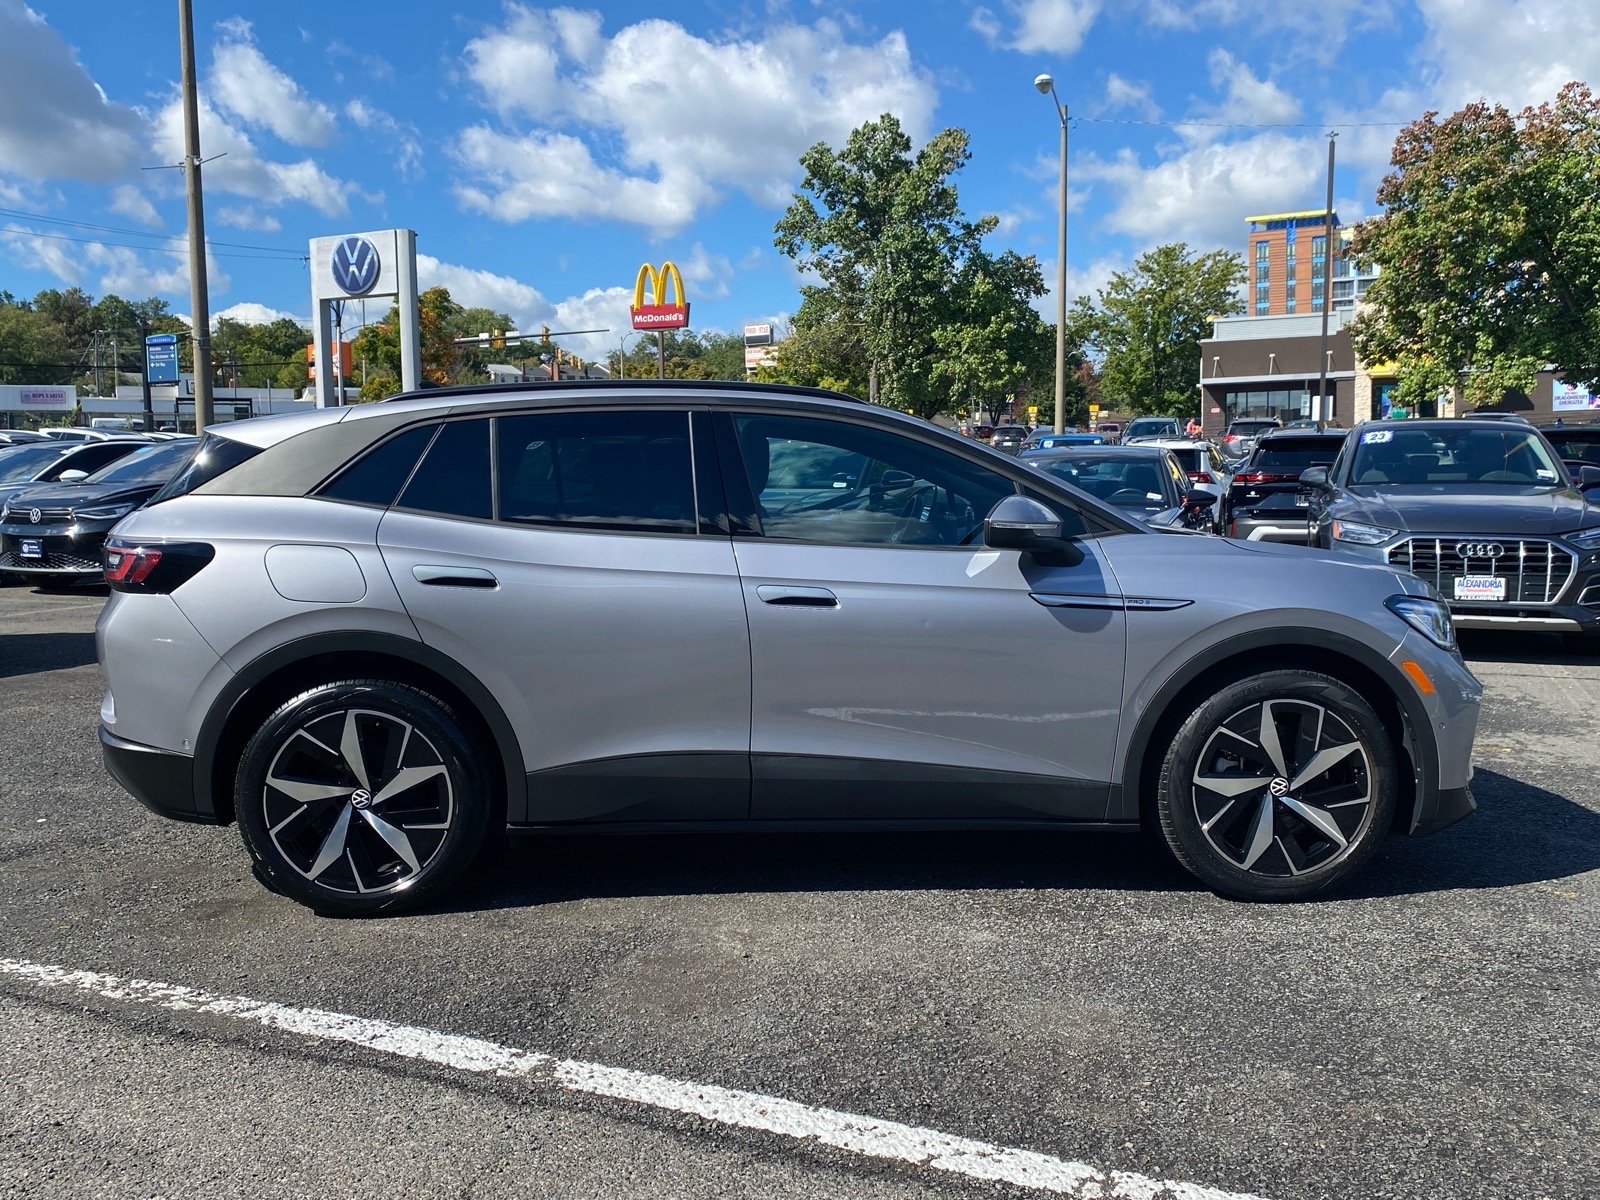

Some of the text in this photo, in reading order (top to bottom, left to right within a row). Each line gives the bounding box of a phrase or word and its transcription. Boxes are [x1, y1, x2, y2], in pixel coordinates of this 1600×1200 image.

[634, 313, 684, 323] McDonald's
[1370, 433, 1386, 441] 23
[1457, 579, 1503, 588] ALEXANDRIA
